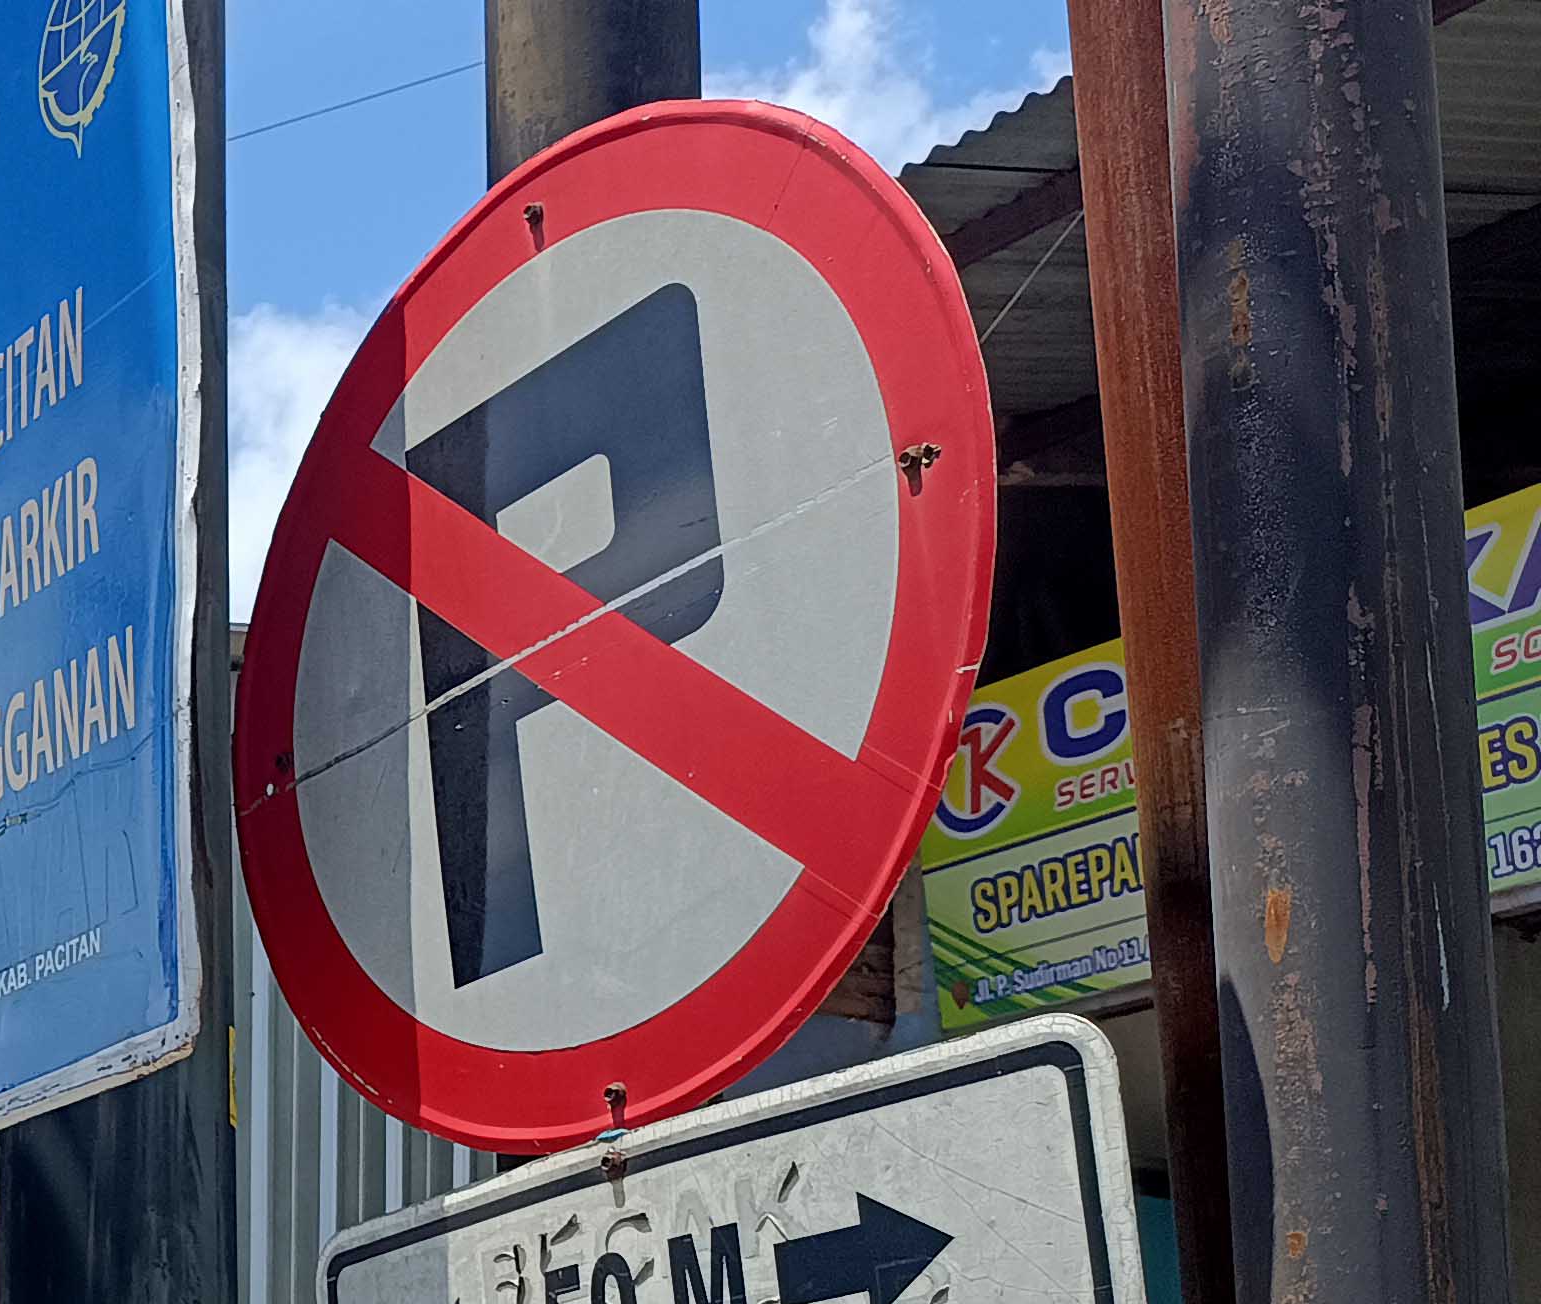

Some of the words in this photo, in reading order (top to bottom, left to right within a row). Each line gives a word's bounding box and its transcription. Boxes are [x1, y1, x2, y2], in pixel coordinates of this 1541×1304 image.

[973, 835, 1143, 932] SPAREPA
[34, 927, 101, 982] PACITAN
[1013, 957, 1092, 991] Sudirman
